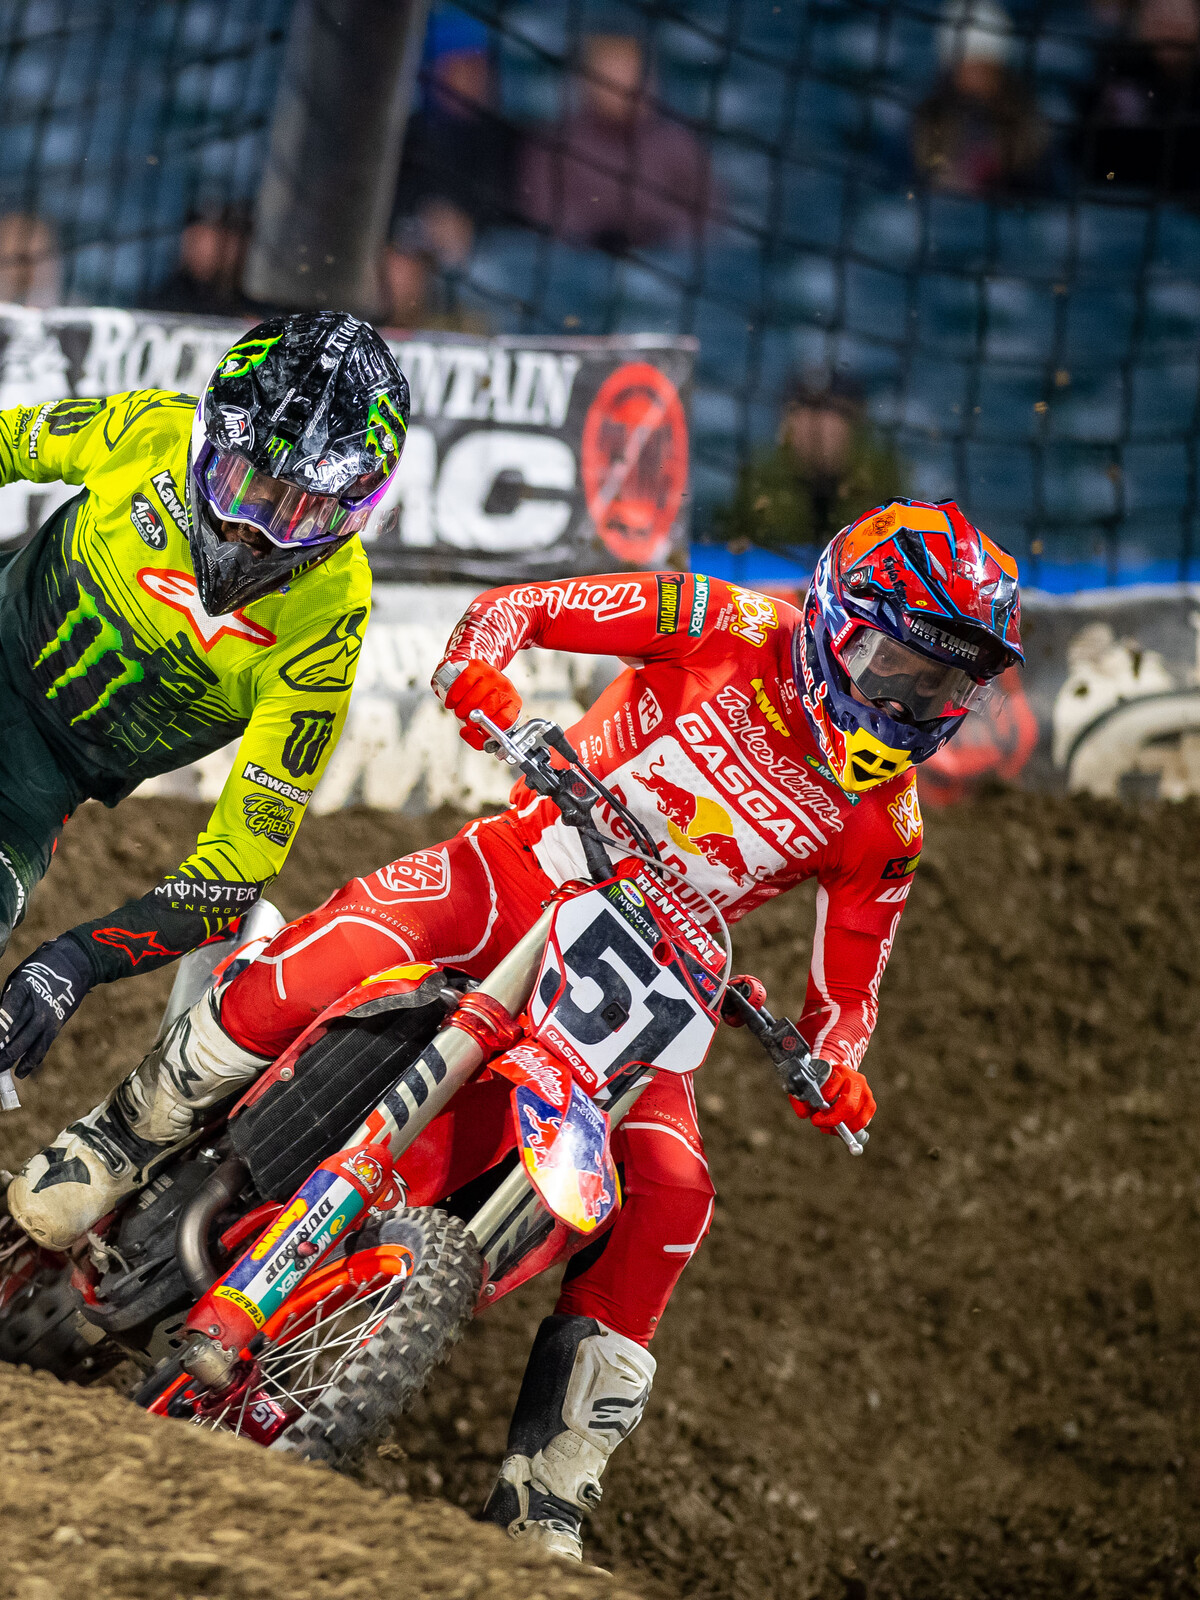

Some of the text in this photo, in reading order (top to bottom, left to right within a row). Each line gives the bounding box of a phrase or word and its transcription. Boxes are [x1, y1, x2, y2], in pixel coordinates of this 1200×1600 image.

[152, 470, 189, 536] Kawa
[134, 501, 162, 546] Airoh
[688, 581, 709, 635] MOTOREX
[833, 621, 853, 647] OAKLEY
[911, 627, 977, 661] RACE WHEELS
[914, 618, 980, 656] METHOD
[625, 711, 638, 749] DUNLOP
[716, 686, 753, 734] Troy
[767, 756, 844, 833] Designs
[675, 712, 818, 860] GASGAS
[245, 795, 291, 820] TEAM
[249, 814, 295, 837] GREEN
[154, 879, 257, 902] MONSTER
[171, 901, 241, 914] ENERGY
[359, 905, 377, 915] LEE
[379, 912, 421, 942] DESIGNS
[618, 894, 660, 943] MONSTER
[635, 873, 716, 967] RENTHAL
[25, 975, 66, 1021] ASTARS
[538, 907, 698, 1081] 51
[545, 1028, 596, 1085] GASGAS
[220, 1289, 264, 1325] ACERBIS
[251, 1400, 277, 1431] 51
